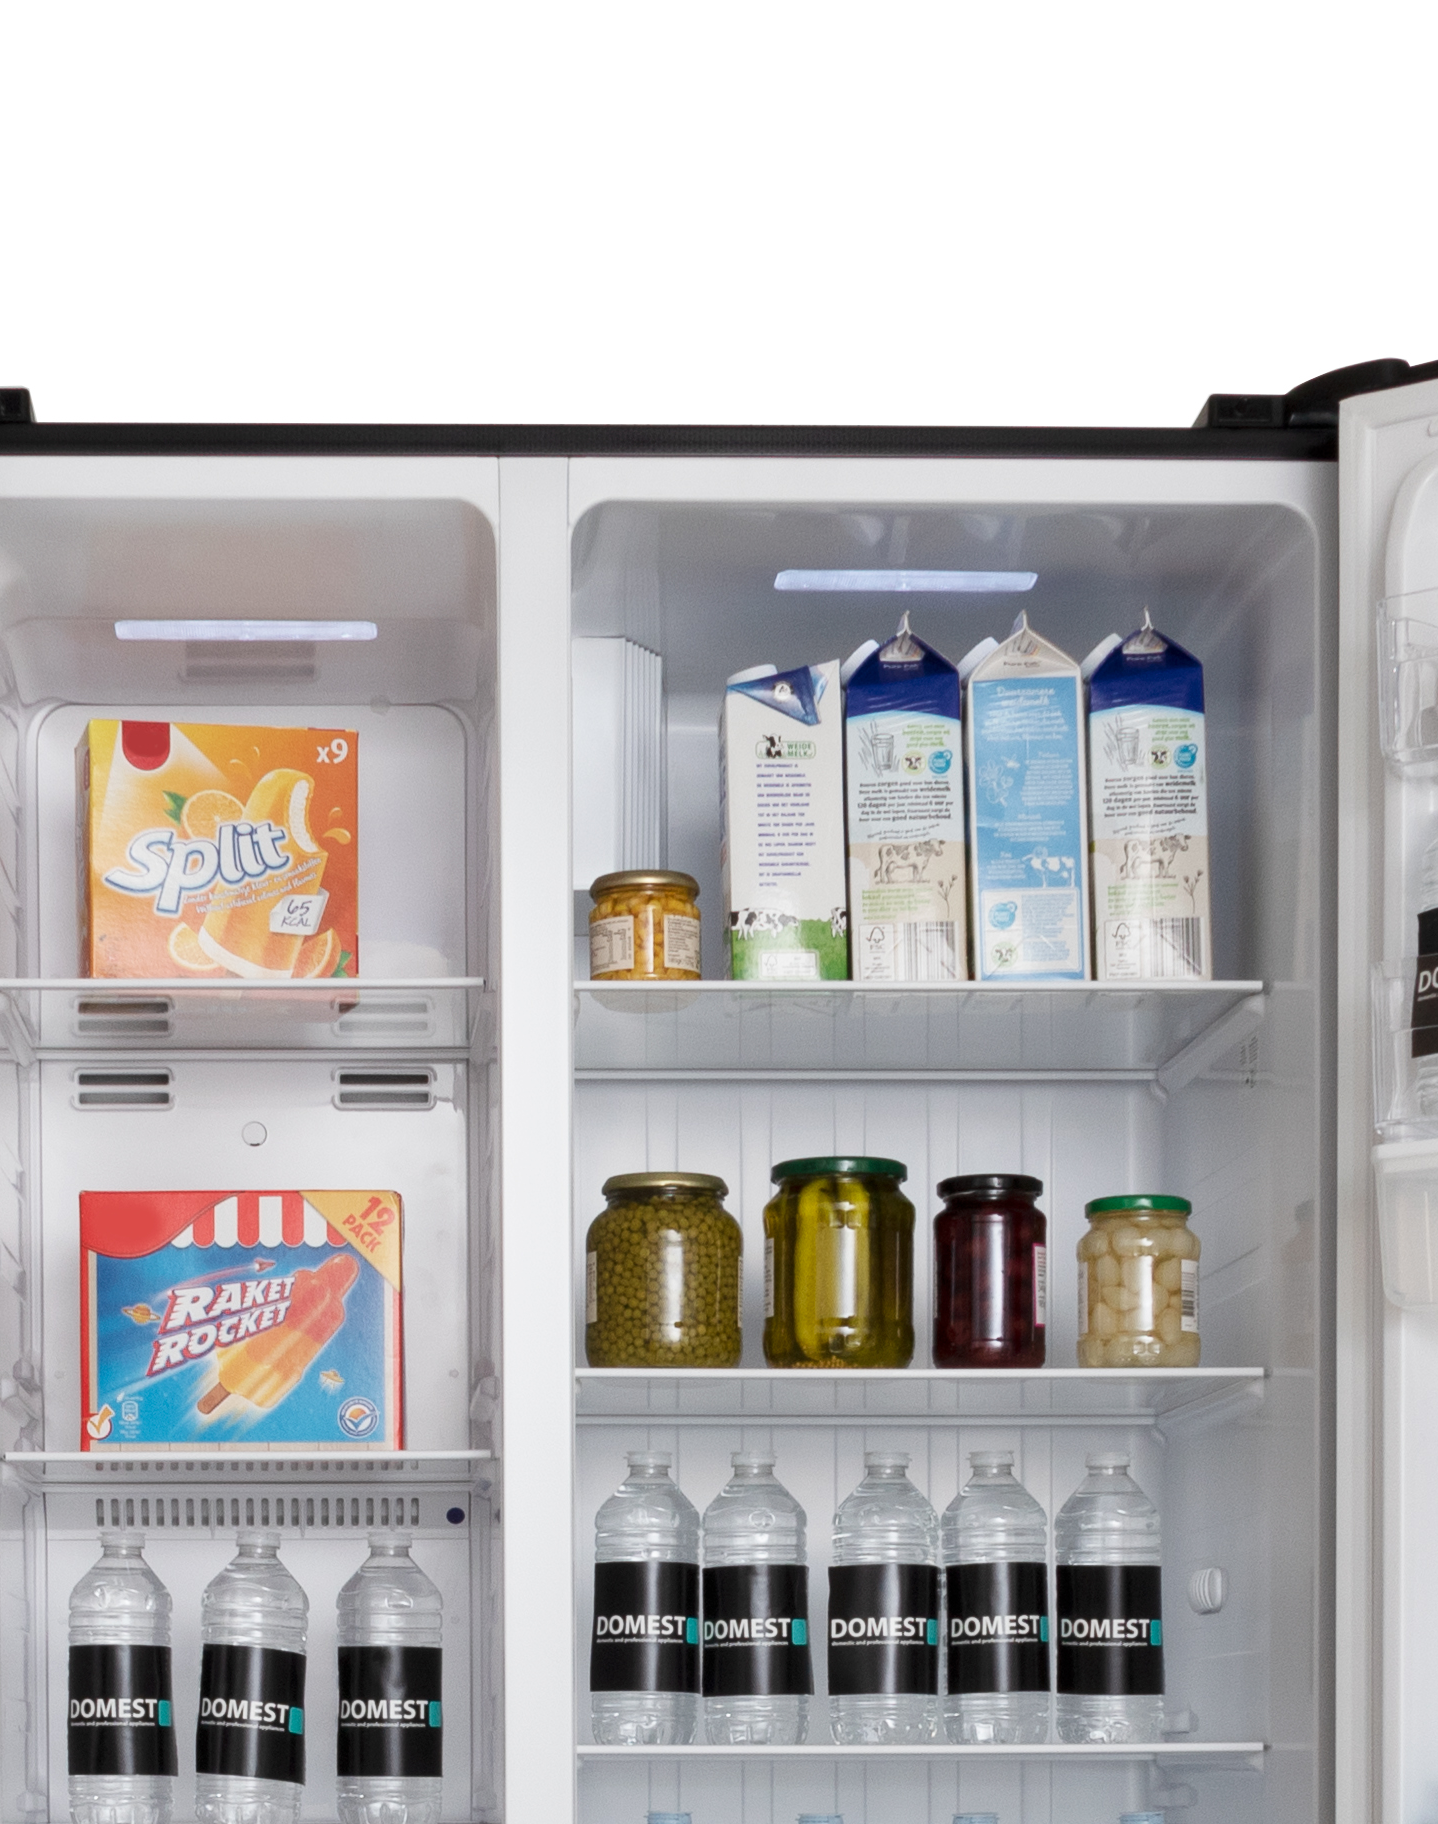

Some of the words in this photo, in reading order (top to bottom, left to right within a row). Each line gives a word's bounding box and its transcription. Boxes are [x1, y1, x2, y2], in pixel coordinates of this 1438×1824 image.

[316, 738, 349, 764] x9
[104, 822, 290, 915] Split
[286, 899, 313, 916] 65
[358, 1195, 395, 1237] 12
[341, 1212, 381, 1254] PACK
[158, 1276, 295, 1335] RAKET
[146, 1299, 292, 1377] ROCKET
[596, 1614, 686, 1636] DOMEST
[704, 1617, 791, 1640] DOMEST
[831, 1616, 927, 1639] DOMEST
[951, 1614, 1039, 1638] DOMEST
[1061, 1618, 1150, 1639] DOMEST
[70, 1698, 158, 1720] DOMEST
[201, 1697, 289, 1725] DOMEST
[340, 1699, 429, 1720] DOMEST
